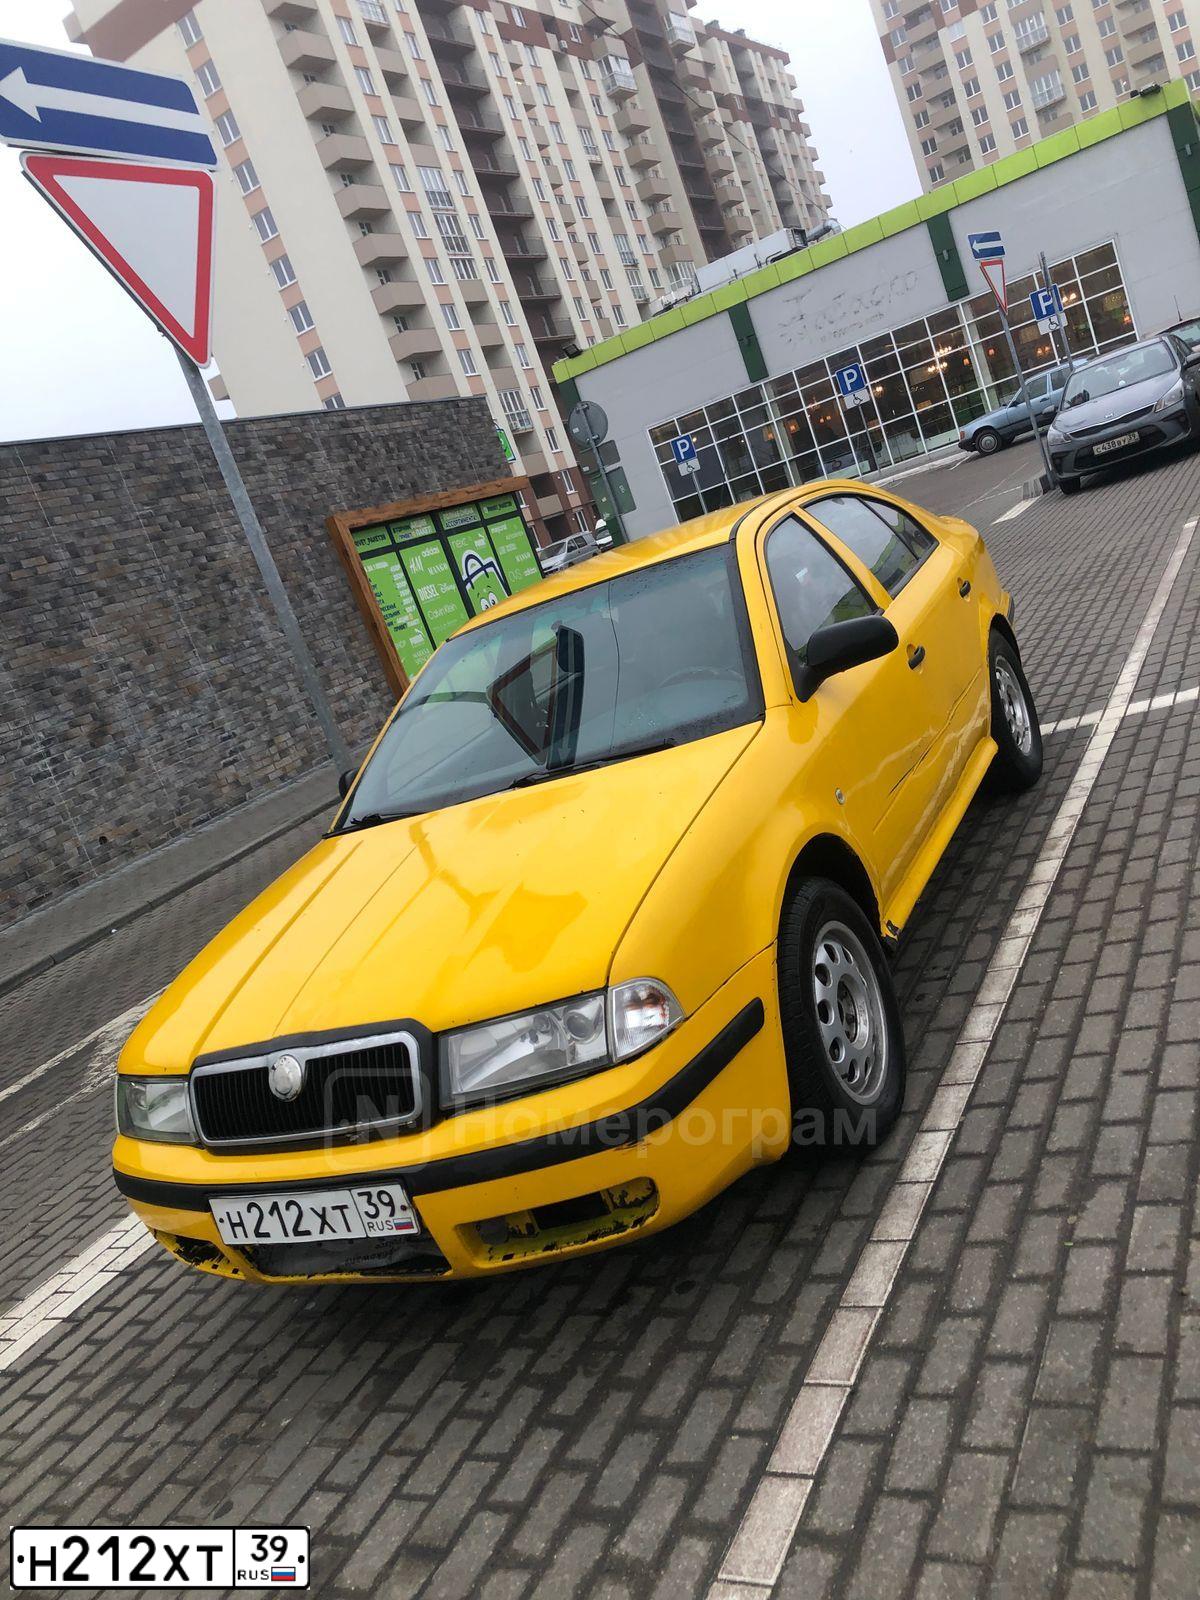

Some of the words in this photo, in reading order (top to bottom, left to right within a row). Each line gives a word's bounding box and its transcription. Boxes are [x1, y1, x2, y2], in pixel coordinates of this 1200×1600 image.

[842, 368, 858, 391] P
[676, 441, 690, 460] P
[417, 584, 440, 602] DIESEL
[225, 1199, 352, 1239] Н212ХТ
[357, 1189, 396, 1219] 39
[367, 1220, 394, 1233] RUS
